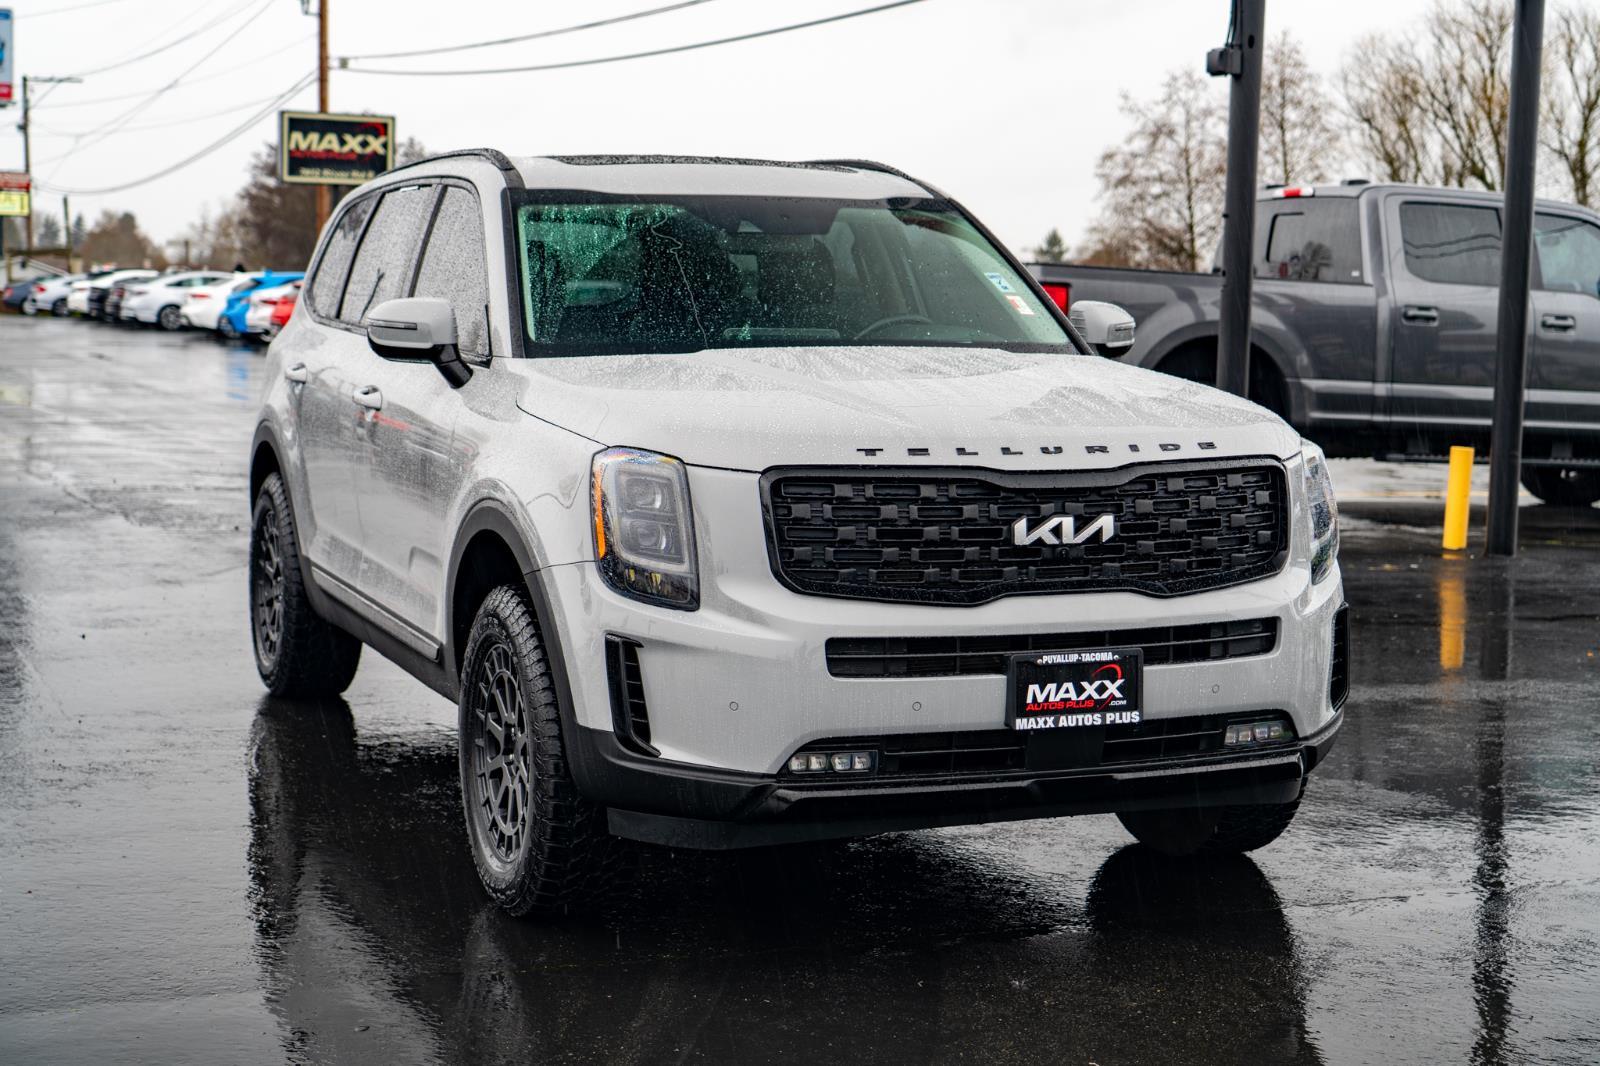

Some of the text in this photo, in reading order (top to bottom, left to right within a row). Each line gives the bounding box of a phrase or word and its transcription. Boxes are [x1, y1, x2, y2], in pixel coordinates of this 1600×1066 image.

[288, 130, 387, 155] MAXX
[856, 441, 1217, 456] TELLURIDE
[1011, 513, 1115, 546] KIA
[1026, 679, 1125, 703] MAXX
[1025, 699, 1095, 711] AUTOS PLUS
[1015, 710, 1140, 731] MAXX AUTOS PLUS
